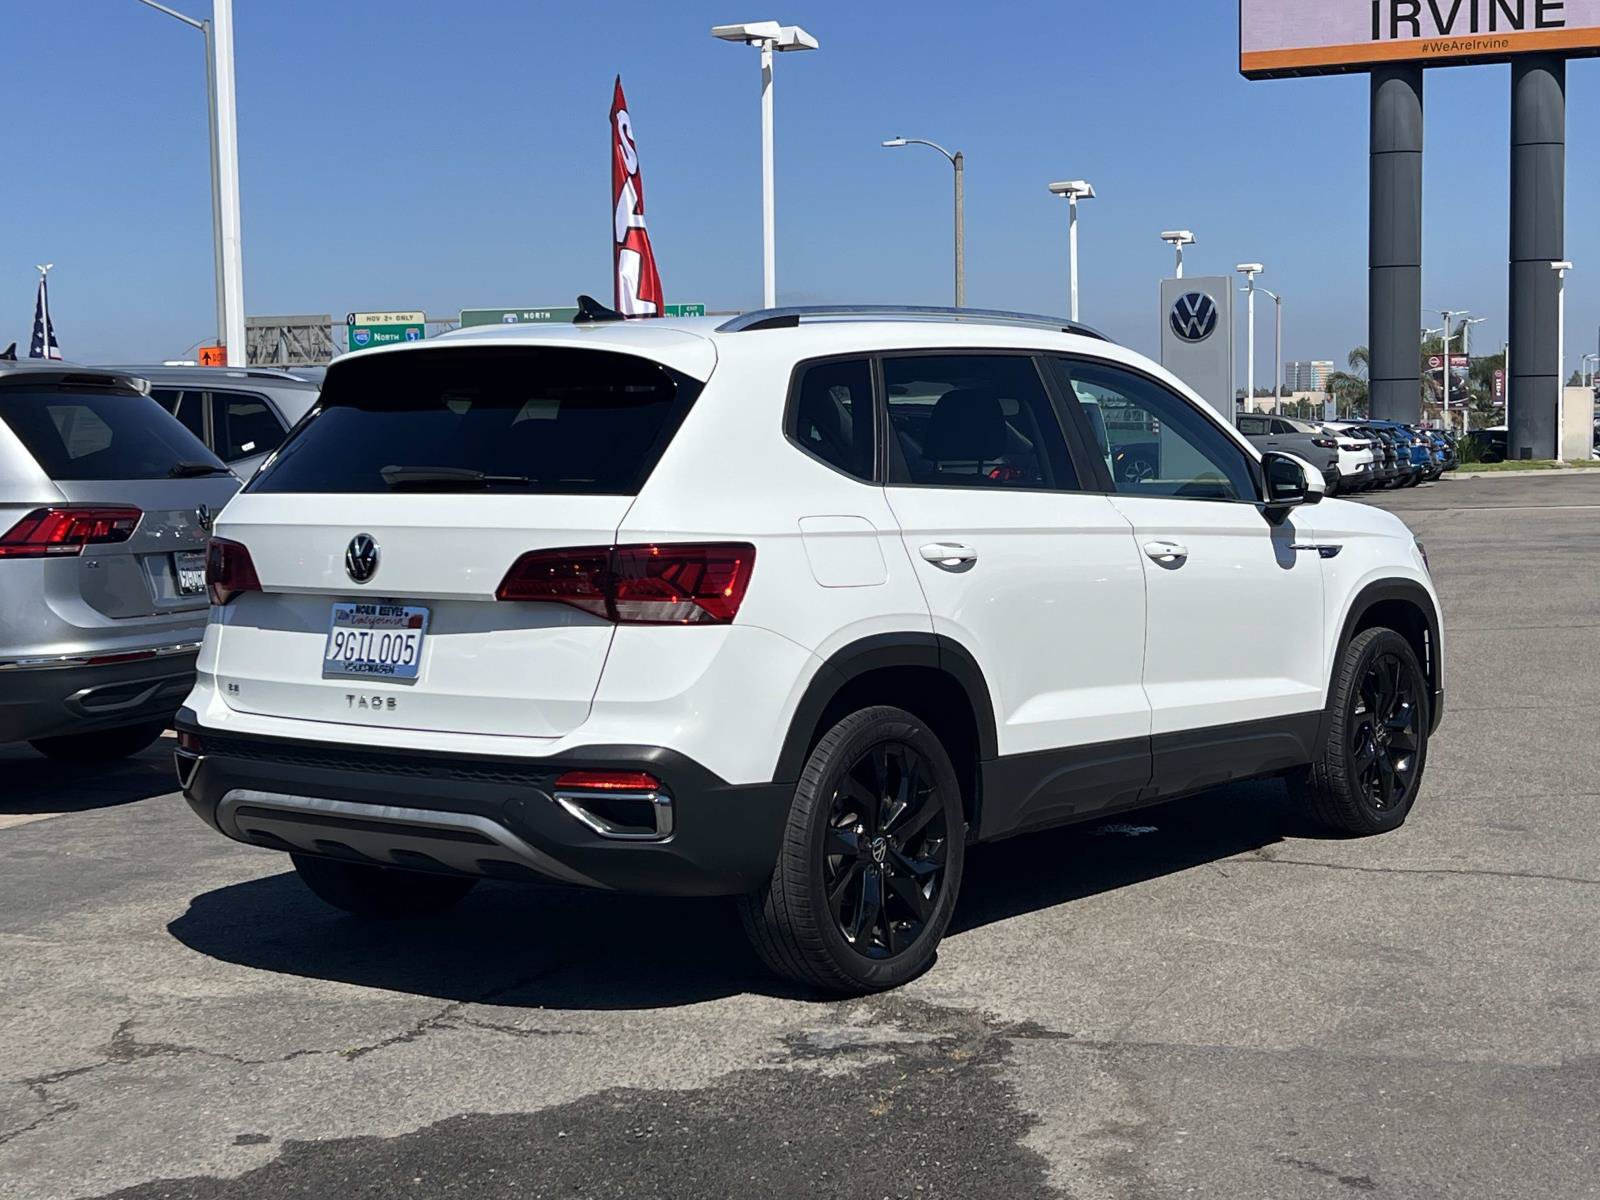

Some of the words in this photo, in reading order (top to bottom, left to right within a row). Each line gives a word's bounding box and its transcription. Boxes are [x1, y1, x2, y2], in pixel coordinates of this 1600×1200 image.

[1371, 0, 1566, 40] IRVINE
[1421, 38, 1509, 53] #WeAreIrvine
[523, 312, 551, 320] NORTH
[332, 631, 417, 665] 9GIL005
[345, 694, 397, 711] TAOS
